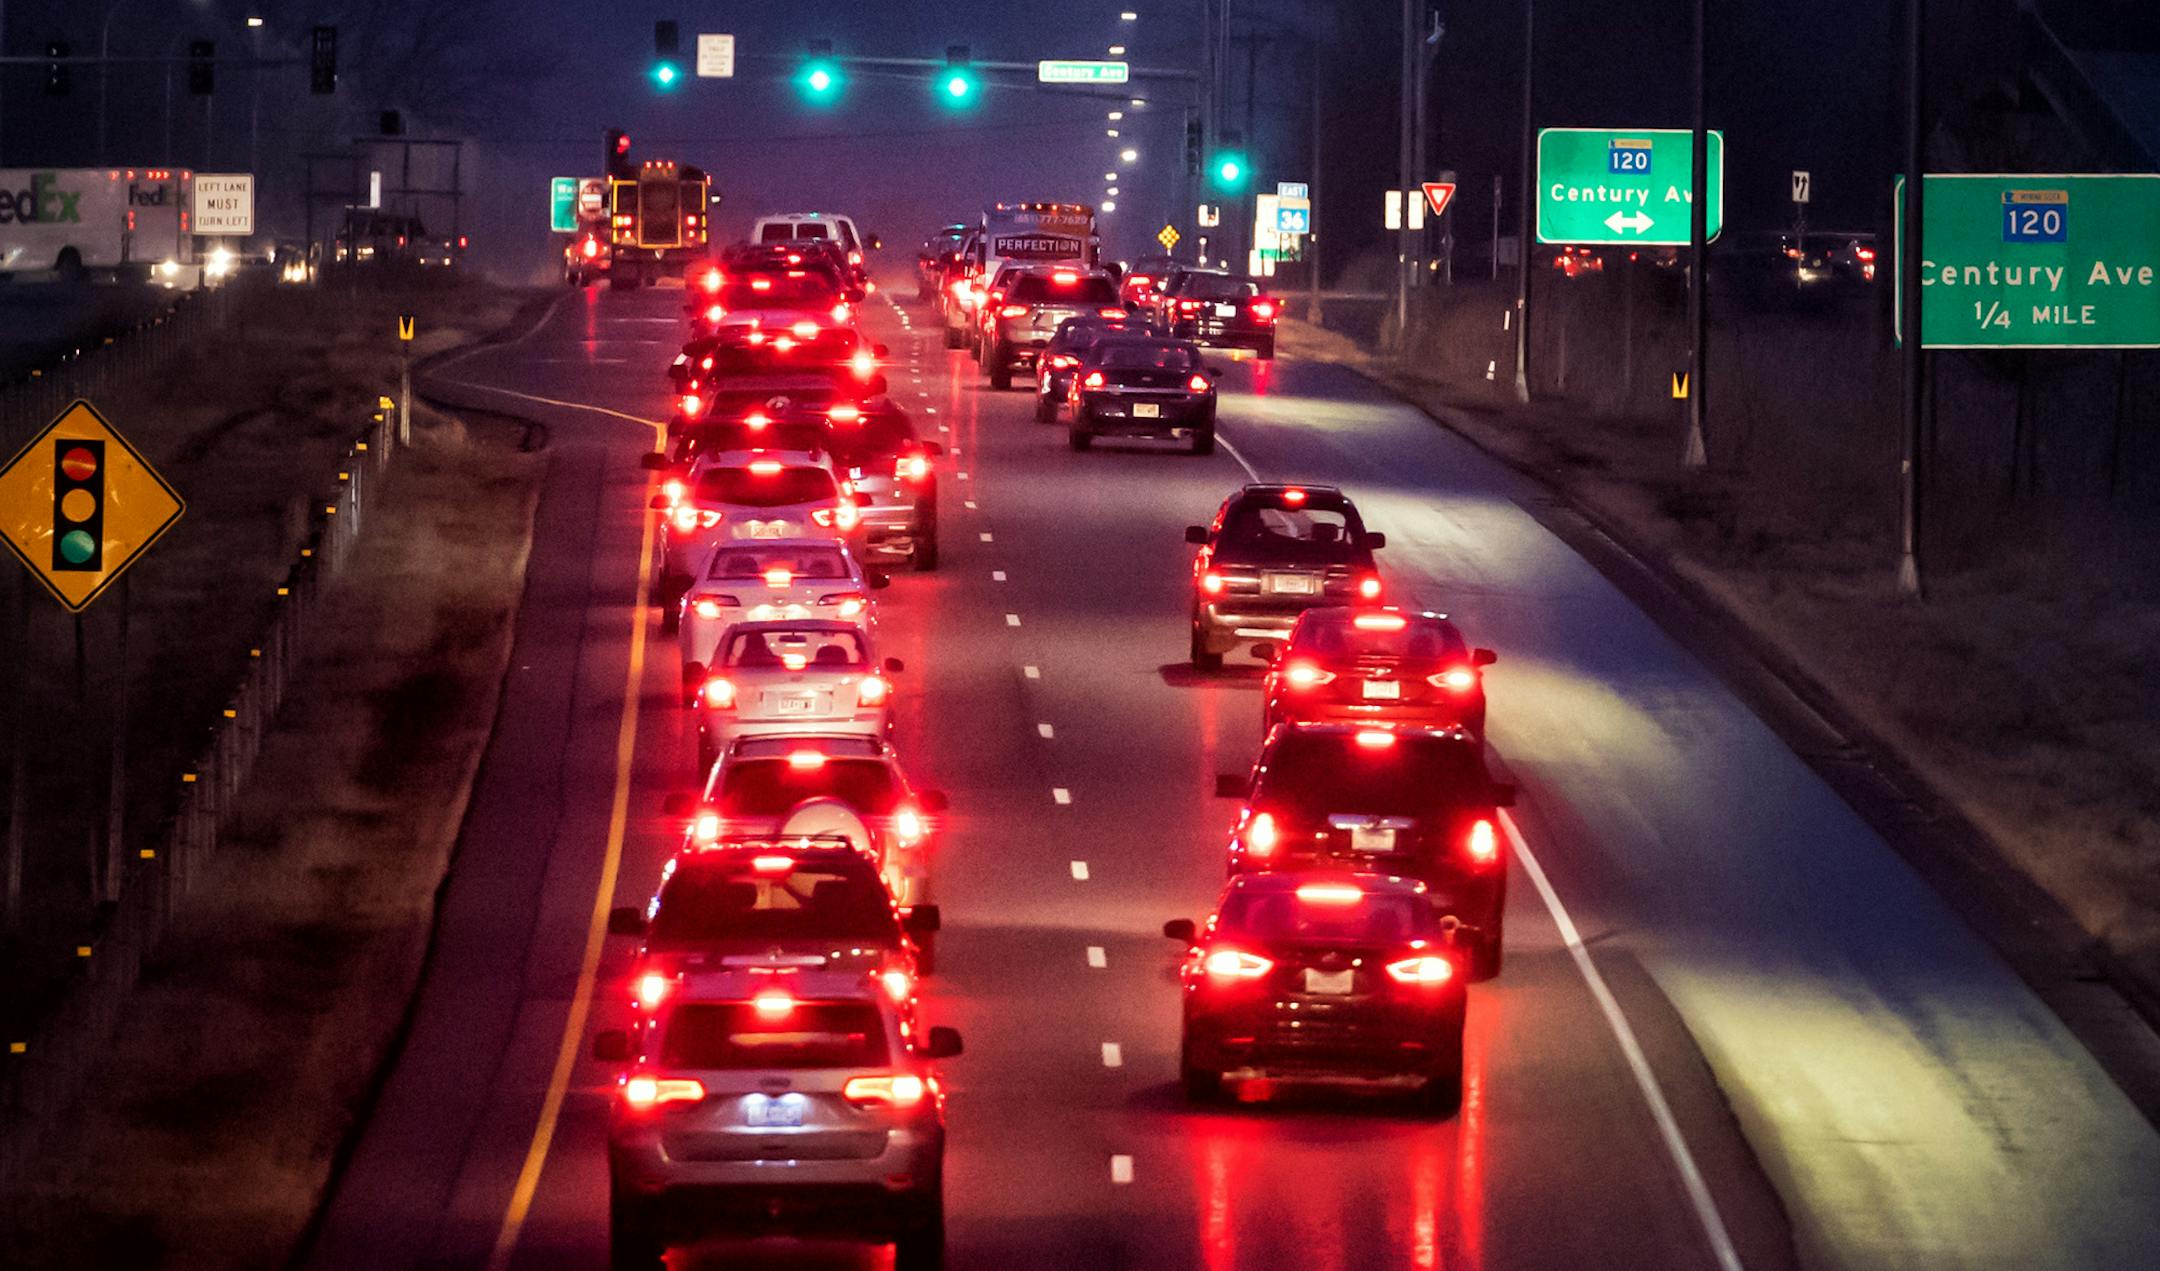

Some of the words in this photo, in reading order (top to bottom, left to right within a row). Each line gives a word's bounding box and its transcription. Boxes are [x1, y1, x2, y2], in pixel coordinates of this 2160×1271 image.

[1612, 152, 1648, 170] 120
[129, 184, 187, 206] FedEx
[198, 183, 220, 192] LEFT
[224, 183, 247, 192] LANE
[1281, 185, 1304, 196] EAST
[1551, 184, 1649, 206] Century
[1664, 186, 1693, 203] Av
[0, 174, 81, 224] edEx
[207, 199, 239, 209] MUST
[199, 217, 222, 225] TURN
[226, 217, 248, 226] LEFT
[1280, 210, 1305, 229] 36
[2009, 210, 2061, 235] 120
[998, 239, 1079, 252] PERFECTION
[1922, 260, 2064, 292] Century
[2087, 261, 2154, 286] Ave
[2032, 305, 2096, 325] MILE
